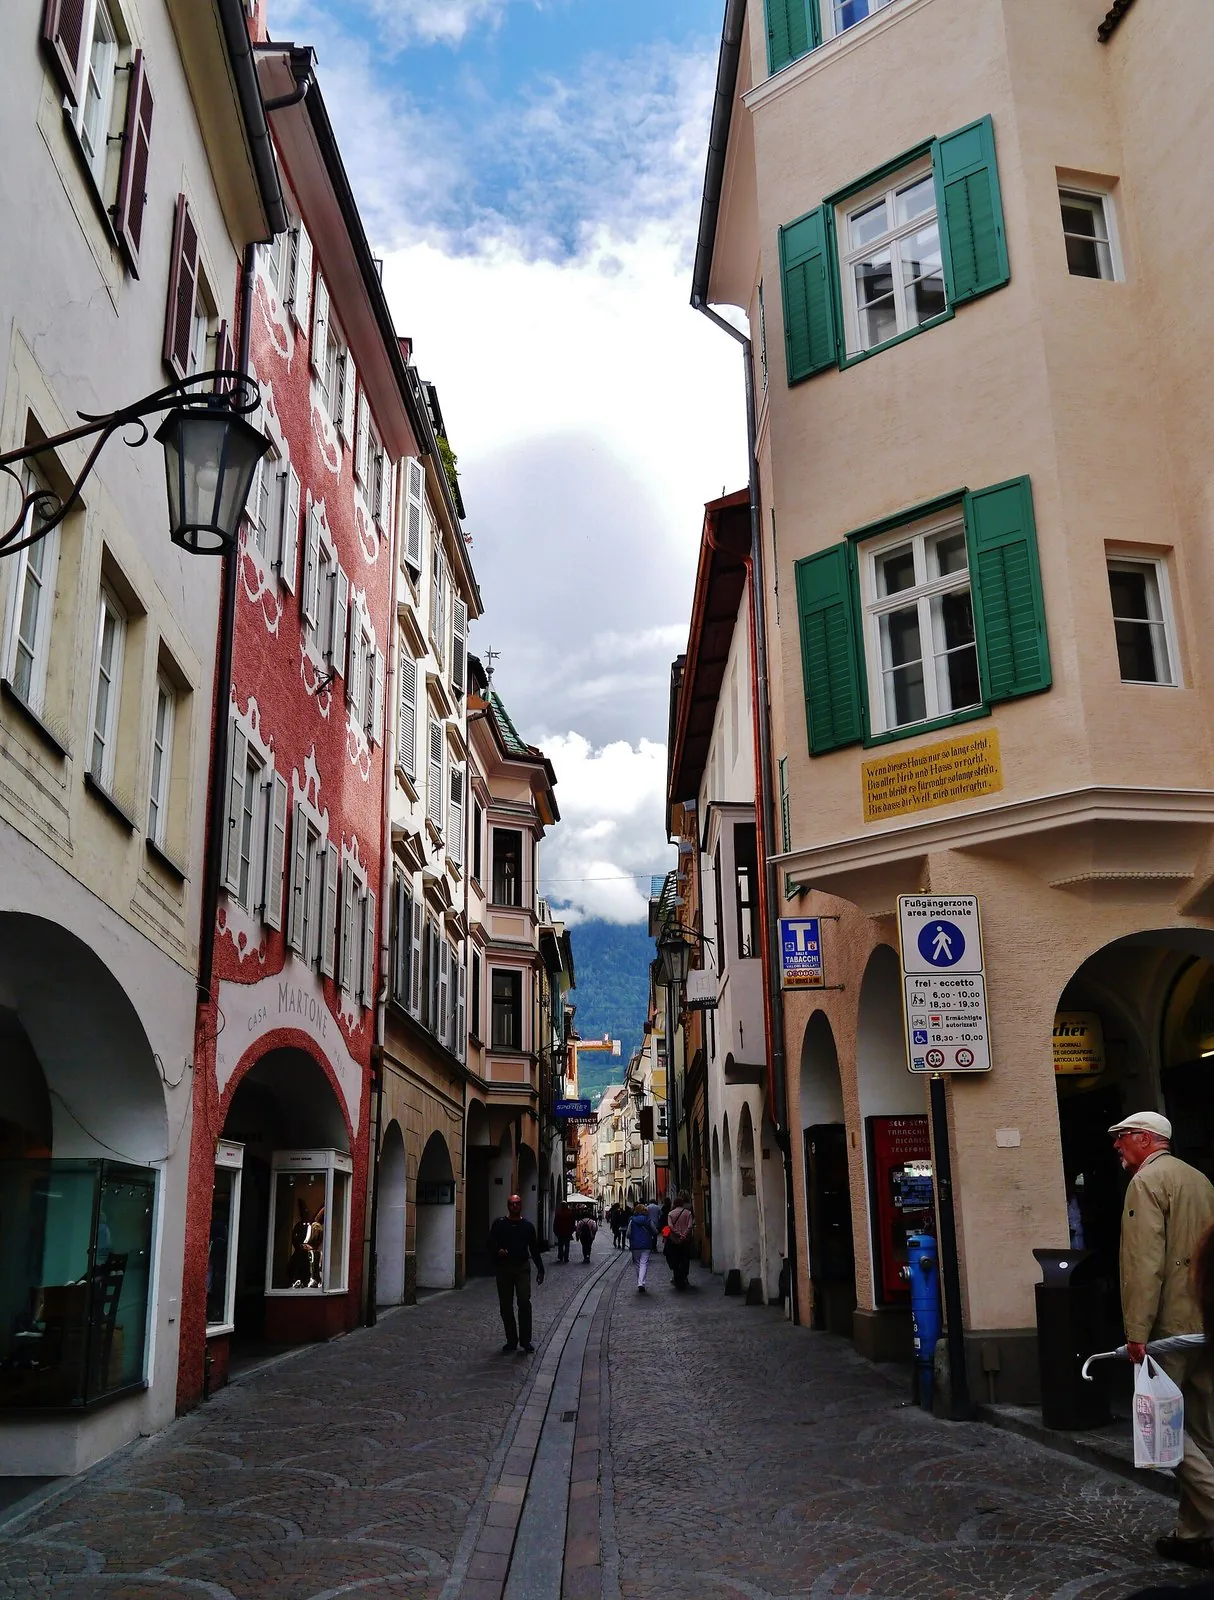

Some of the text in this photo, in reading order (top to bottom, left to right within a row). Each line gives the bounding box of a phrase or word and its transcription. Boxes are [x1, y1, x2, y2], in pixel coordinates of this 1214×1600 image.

[907, 757, 928, 768] Haus
[929, 752, 942, 762] nur
[941, 750, 950, 758] so
[950, 745, 970, 757] lange
[867, 780, 880, 791] Bis
[896, 770, 914, 783] Neid
[915, 767, 929, 779] und
[930, 763, 953, 775] Hass
[868, 791, 888, 803] Dann
[889, 784, 907, 797] bleibt
[908, 785, 918, 793] es
[868, 804, 883, 815] Bis
[901, 797, 912, 807] die
[912, 792, 930, 804] Welt
[932, 788, 949, 800] wird
[904, 899, 973, 909] Fußgängerzone
[930, 909, 971, 917] pedonale
[788, 922, 811, 951] T
[786, 955, 819, 963] TABACCHI
[940, 979, 974, 987] eccetto
[247, 982, 327, 1038] CASA MARTONE
[1053, 1022, 1088, 1036] cher
[932, 1034, 953, 1042] 18.30
